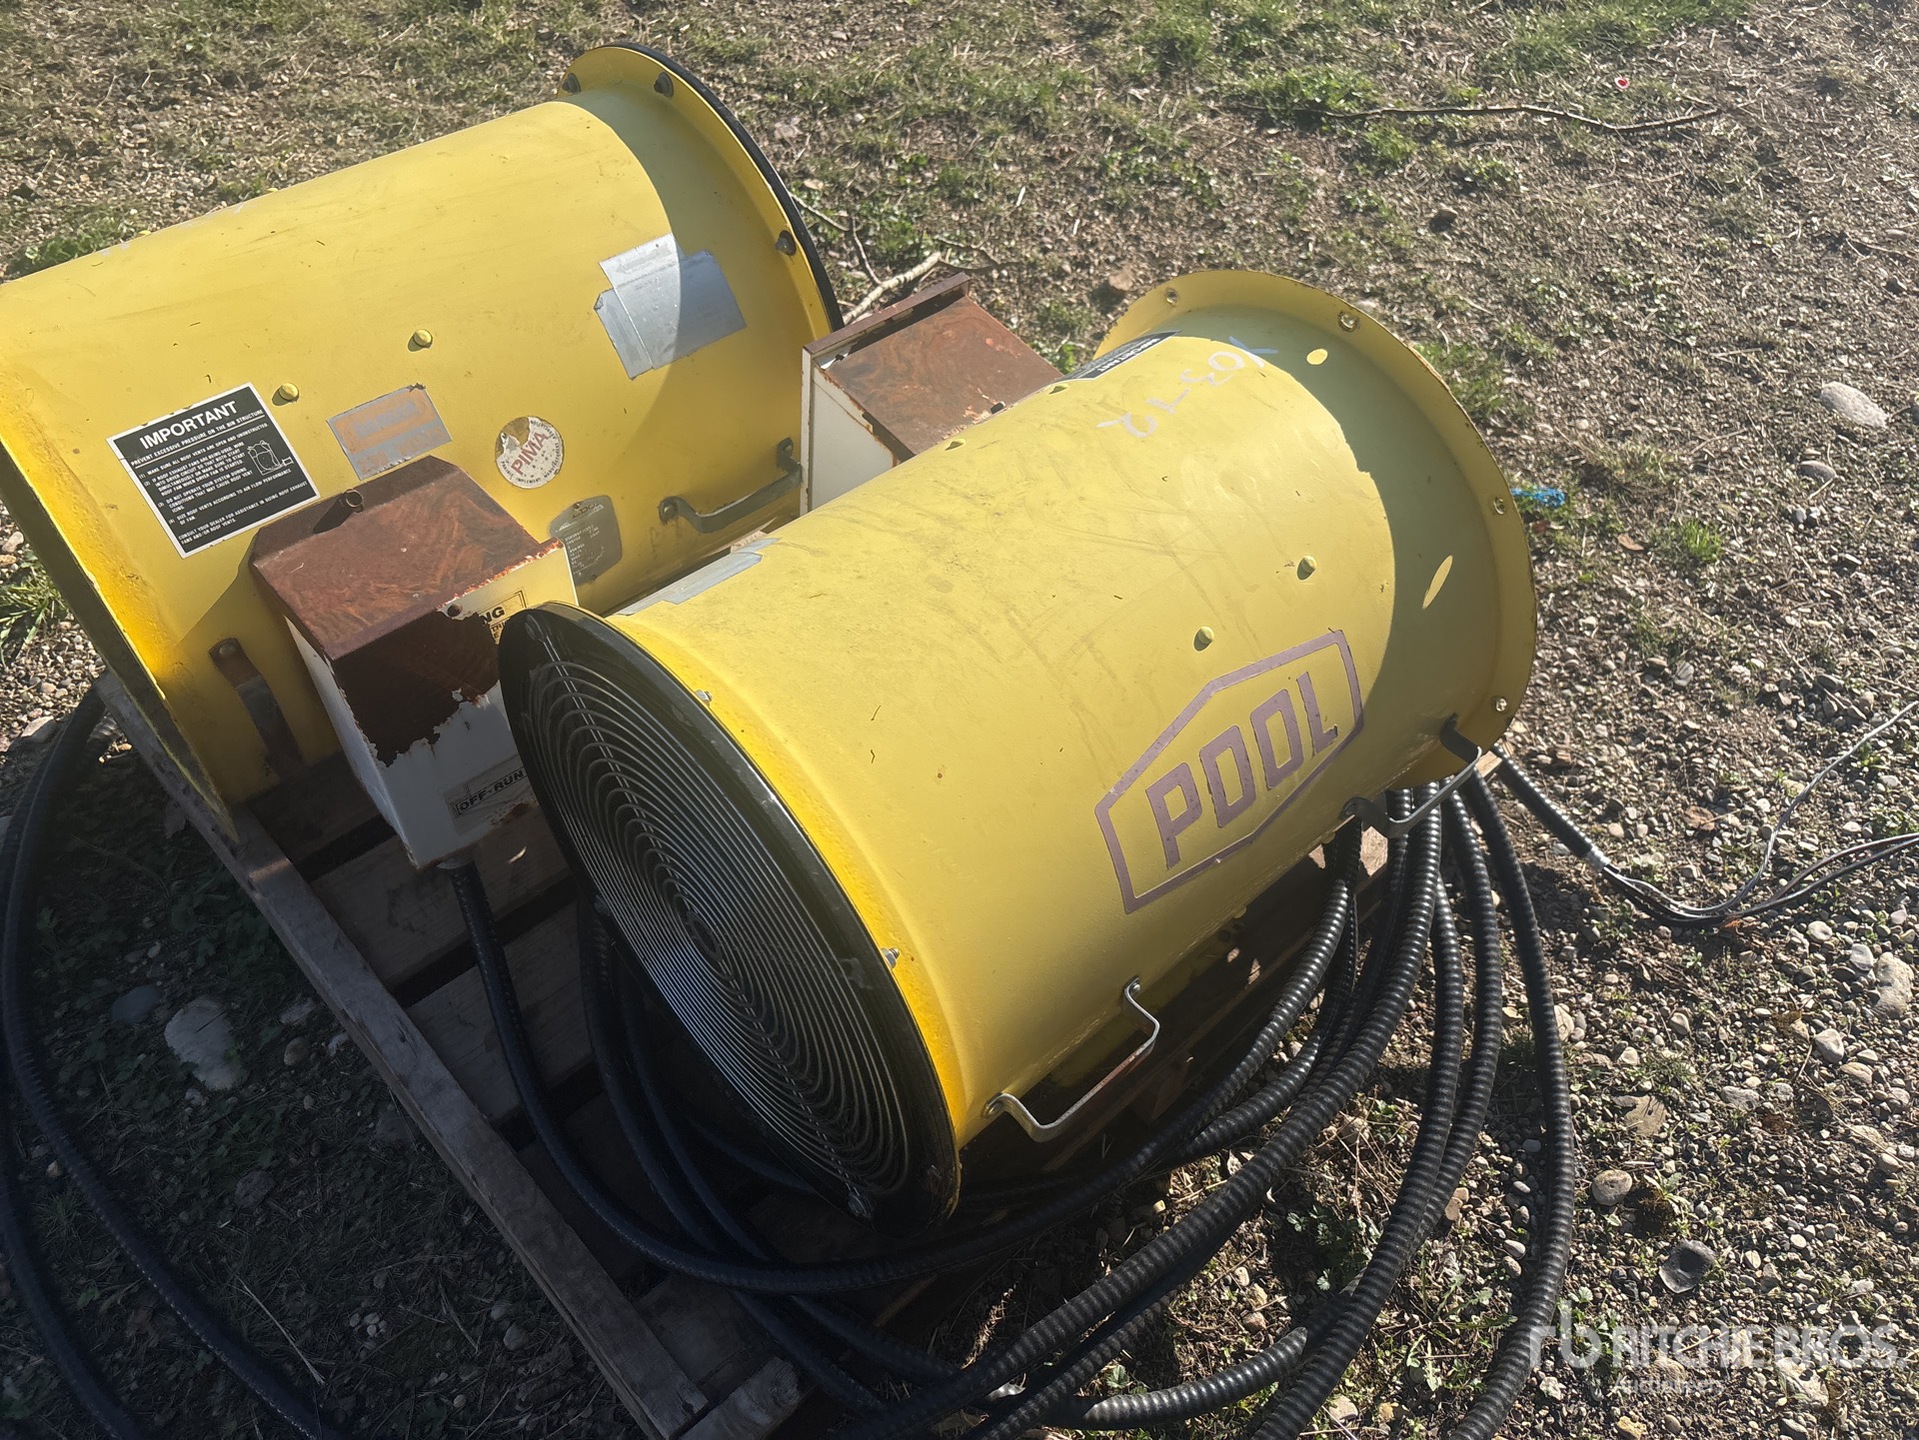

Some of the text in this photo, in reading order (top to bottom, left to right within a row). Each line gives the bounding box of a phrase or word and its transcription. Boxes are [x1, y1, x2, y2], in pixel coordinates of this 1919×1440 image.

[129, 453, 154, 466] PREVENT
[152, 442, 181, 457] EXCESSIVE
[180, 431, 207, 446] PRESSURE
[215, 423, 226, 432] THE
[225, 419, 236, 427] BIN
[235, 408, 263, 423] STRUCTURE
[138, 400, 237, 449] IMPORTANT
[511, 432, 549, 476] PIMA
[1145, 671, 1338, 870] POOL
